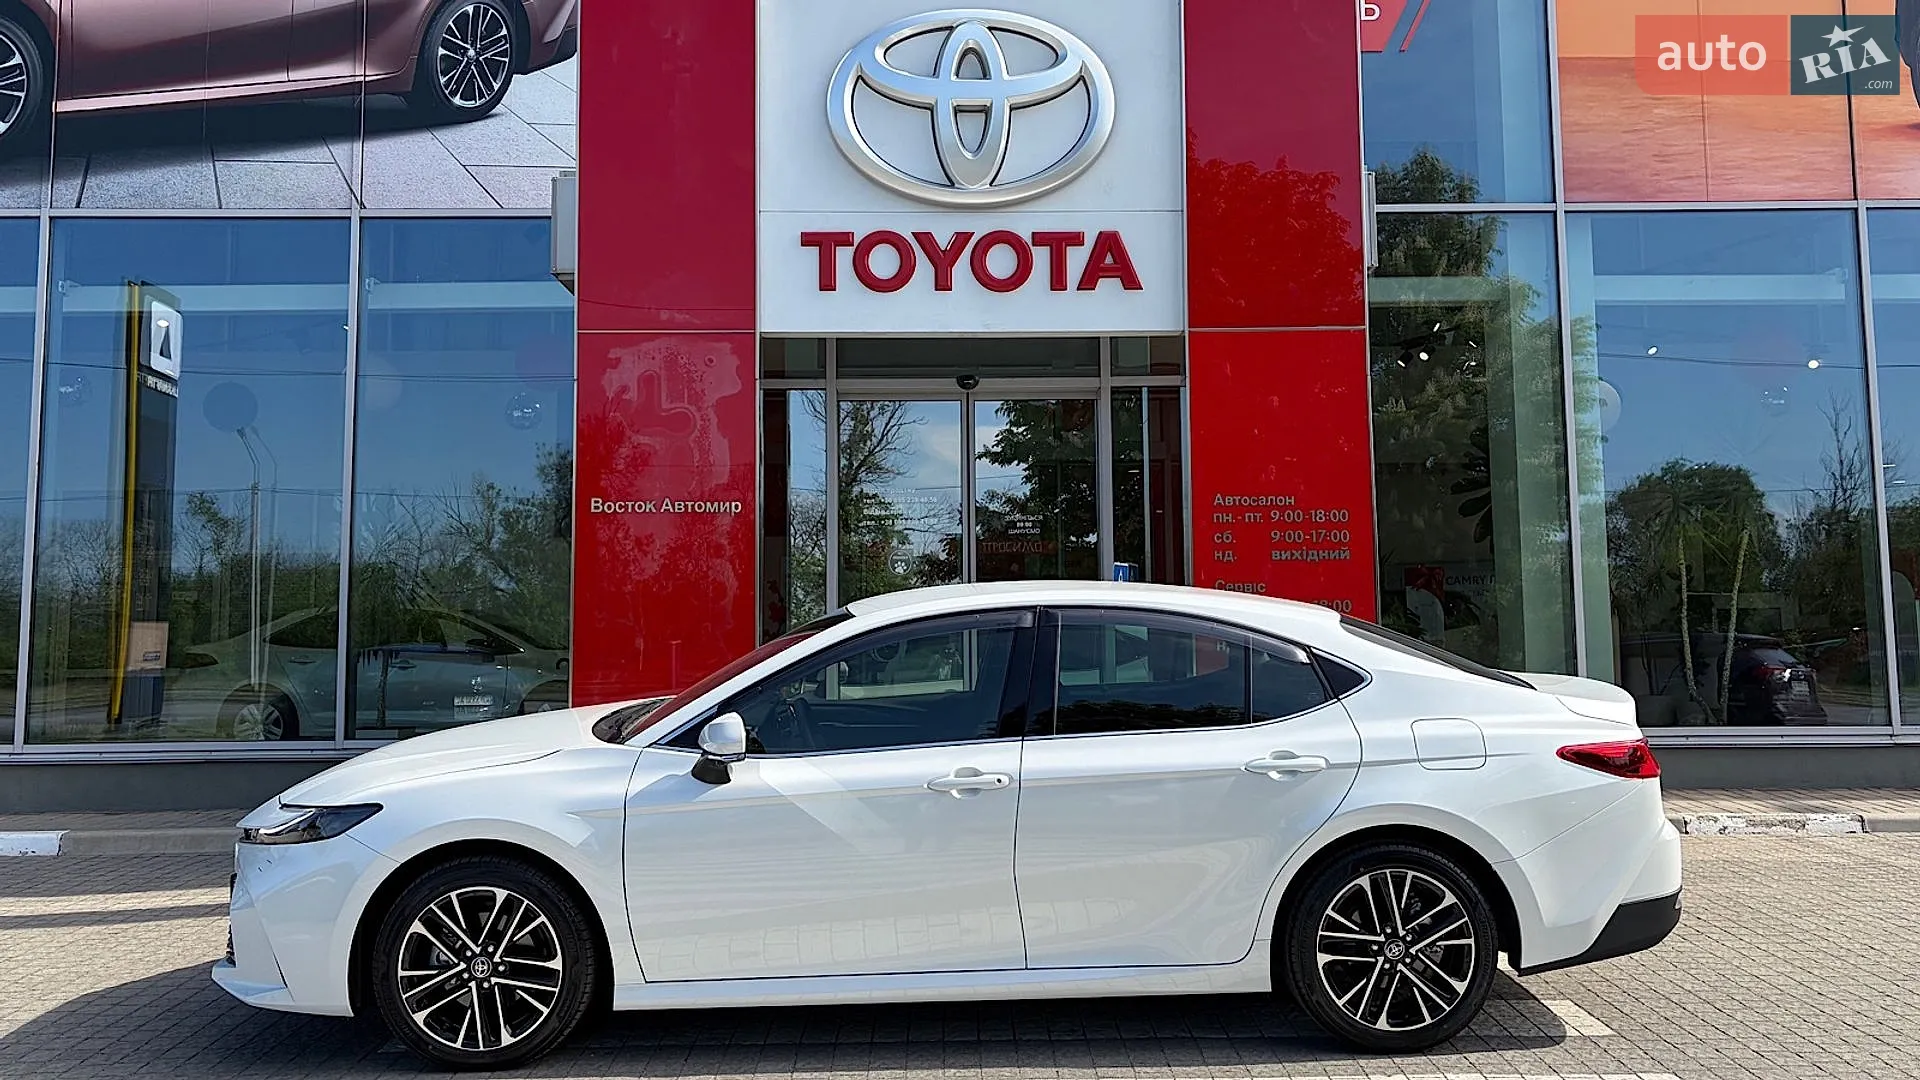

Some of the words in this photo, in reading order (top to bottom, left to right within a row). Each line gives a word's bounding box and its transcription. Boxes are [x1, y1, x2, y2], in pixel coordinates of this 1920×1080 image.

[801, 230, 1143, 293] TOYOTA
[1213, 493, 1295, 506] Автосалон
[590, 497, 657, 513] Восток
[660, 497, 742, 516] Автомир
[1271, 509, 1349, 522] 9:00-18:00
[1214, 530, 1237, 543] сб.
[1271, 530, 1350, 543] 9:00-17:00
[1214, 551, 1237, 562] нд.
[1271, 546, 1350, 562] вихідний
[1446, 575, 1486, 585] CAMRY
